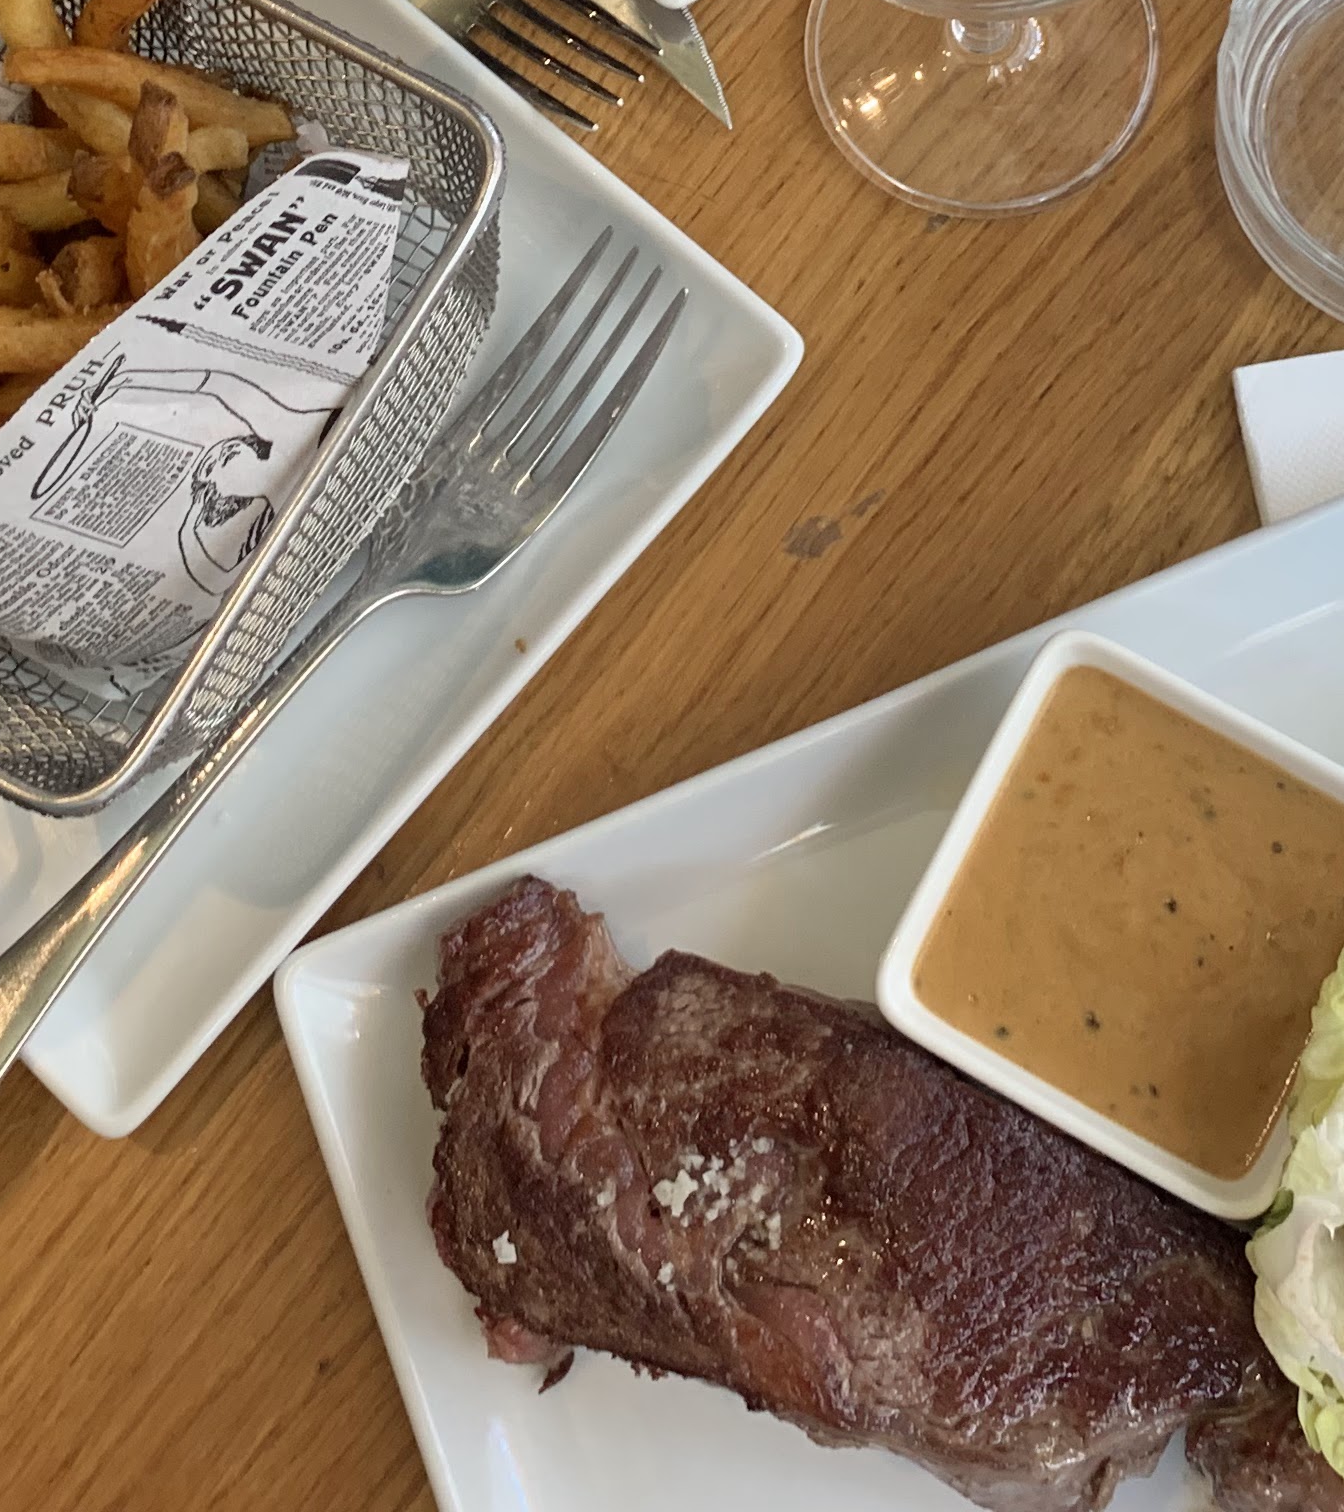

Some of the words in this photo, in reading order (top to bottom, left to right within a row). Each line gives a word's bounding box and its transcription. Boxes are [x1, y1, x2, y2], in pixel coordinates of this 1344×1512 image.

[154, 271, 193, 301] War
[196, 247, 216, 266] or
[216, 188, 279, 242] Peace!
[230, 245, 304, 320] Fountain
[300, 210, 338, 246] Pen
[79, 430, 129, 479] DANCING
